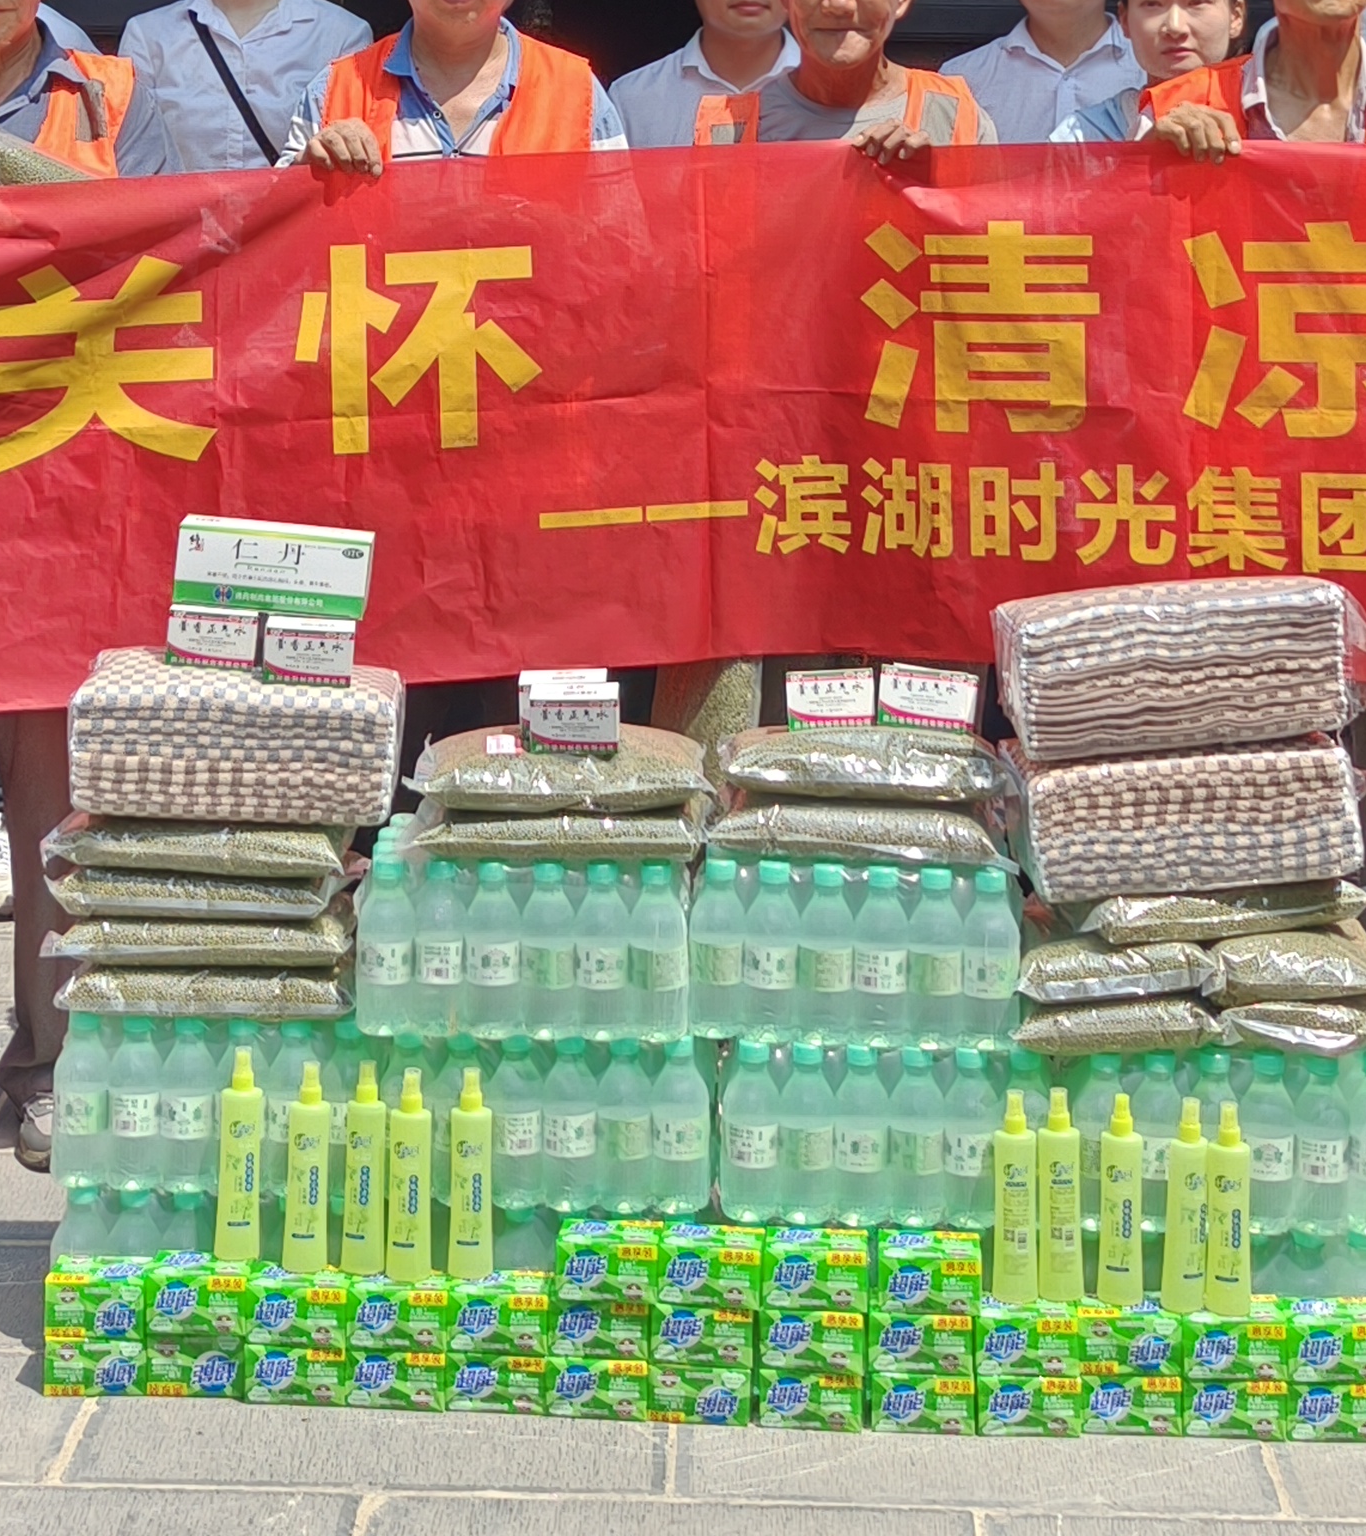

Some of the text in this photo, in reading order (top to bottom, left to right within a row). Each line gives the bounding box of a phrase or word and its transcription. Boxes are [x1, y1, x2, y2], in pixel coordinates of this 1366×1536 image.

[233, 538, 306, 565] 仁丹
[565, 1255, 607, 1281] 超能
[666, 1257, 708, 1283] 超能
[773, 1261, 816, 1285] 超能
[888, 1271, 931, 1295] 超能
[155, 1285, 198, 1311] 超能
[255, 1298, 296, 1324] 超能
[356, 1300, 399, 1326] 超能
[457, 1304, 500, 1330] 超能
[558, 1312, 600, 1336] 超能
[661, 1316, 703, 1341] 超能
[769, 1321, 812, 1345] 超能
[1042, 1320, 1074, 1330] 惠享装
[880, 1326, 923, 1350] 超能
[985, 1330, 1027, 1353] 超能
[1194, 1336, 1237, 1360] 超能
[1299, 1336, 1342, 1361] 超能
[255, 1356, 296, 1383] 超能
[354, 1359, 396, 1385] 超能
[455, 1365, 498, 1392] 超能
[556, 1372, 598, 1396] 超能
[767, 1383, 810, 1407] 超能
[1046, 1379, 1078, 1390] 惠享装
[882, 1390, 924, 1414] 超能
[989, 1389, 1031, 1413] 超能
[1090, 1387, 1132, 1412] 超能
[1193, 1389, 1236, 1413] 超能
[1297, 1393, 1341, 1417] 超能
